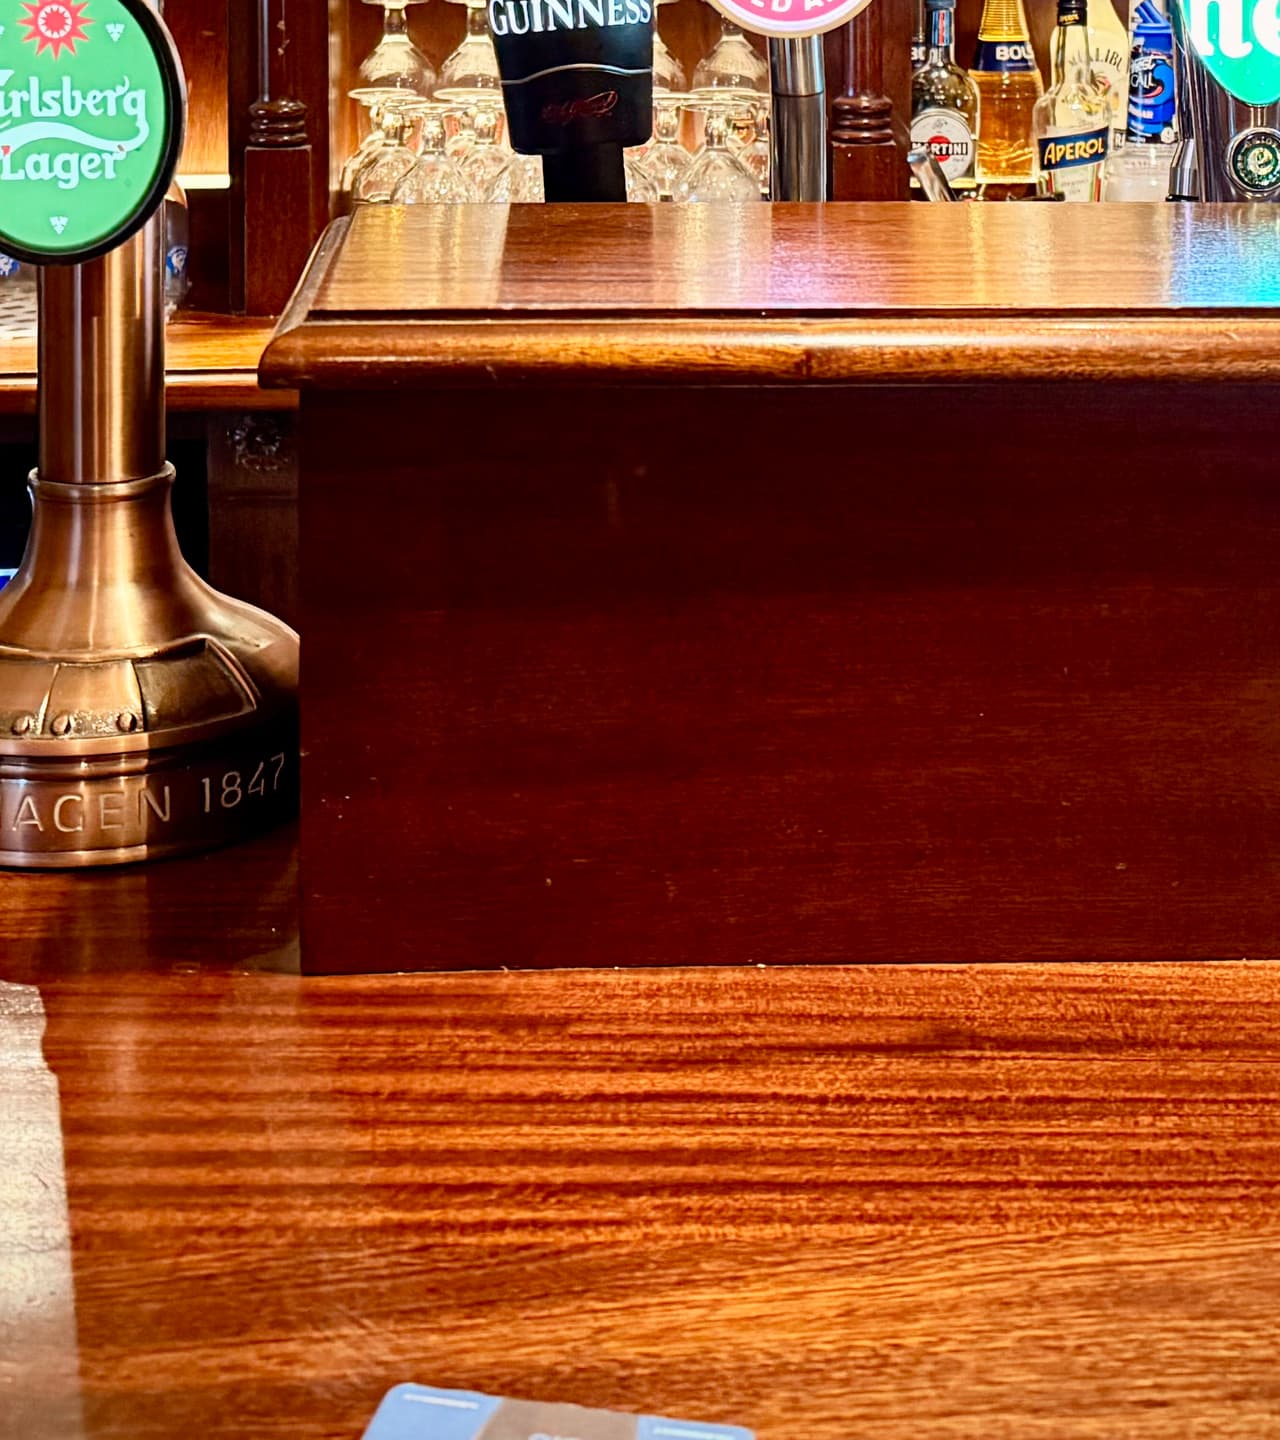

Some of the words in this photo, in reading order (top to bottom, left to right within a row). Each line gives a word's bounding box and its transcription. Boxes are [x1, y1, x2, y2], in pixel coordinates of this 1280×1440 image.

[0, 148, 127, 190] Lager
[1044, 136, 1105, 166] APEROL
[201, 751, 287, 814] 1847
